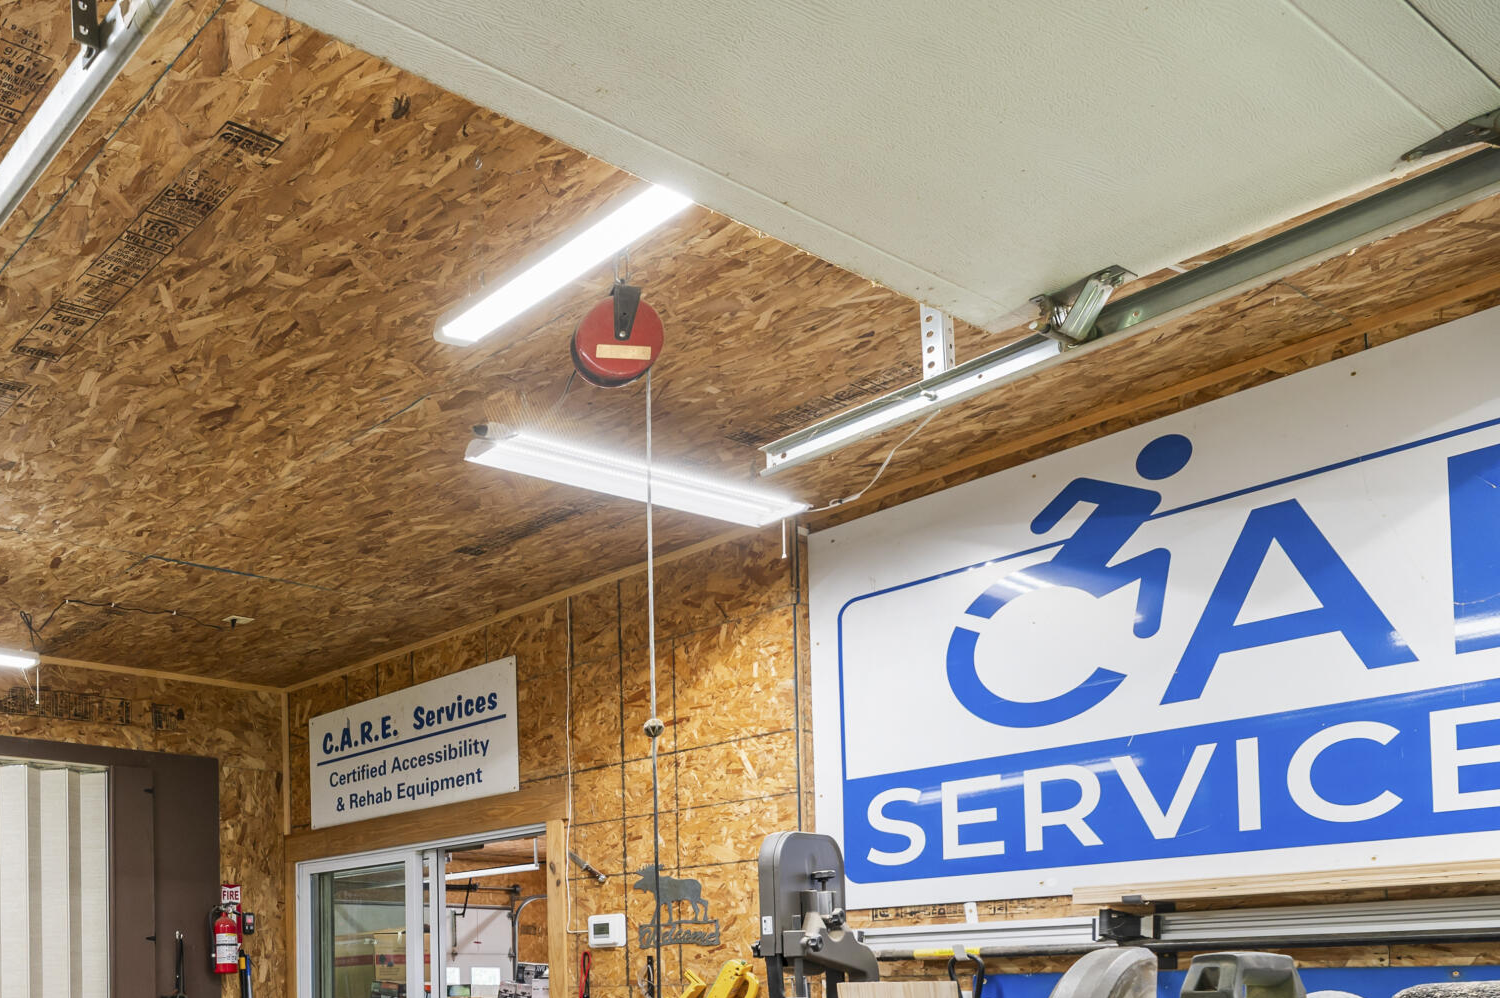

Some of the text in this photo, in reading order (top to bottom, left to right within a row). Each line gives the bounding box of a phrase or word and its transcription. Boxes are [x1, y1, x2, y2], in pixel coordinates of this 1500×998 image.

[322, 692, 498, 755] C.A.R.E. Services
[329, 739, 490, 788] Certified Accessibility
[336, 767, 483, 812] & Rehab Equipment
[222, 890, 240, 901] FIRE
